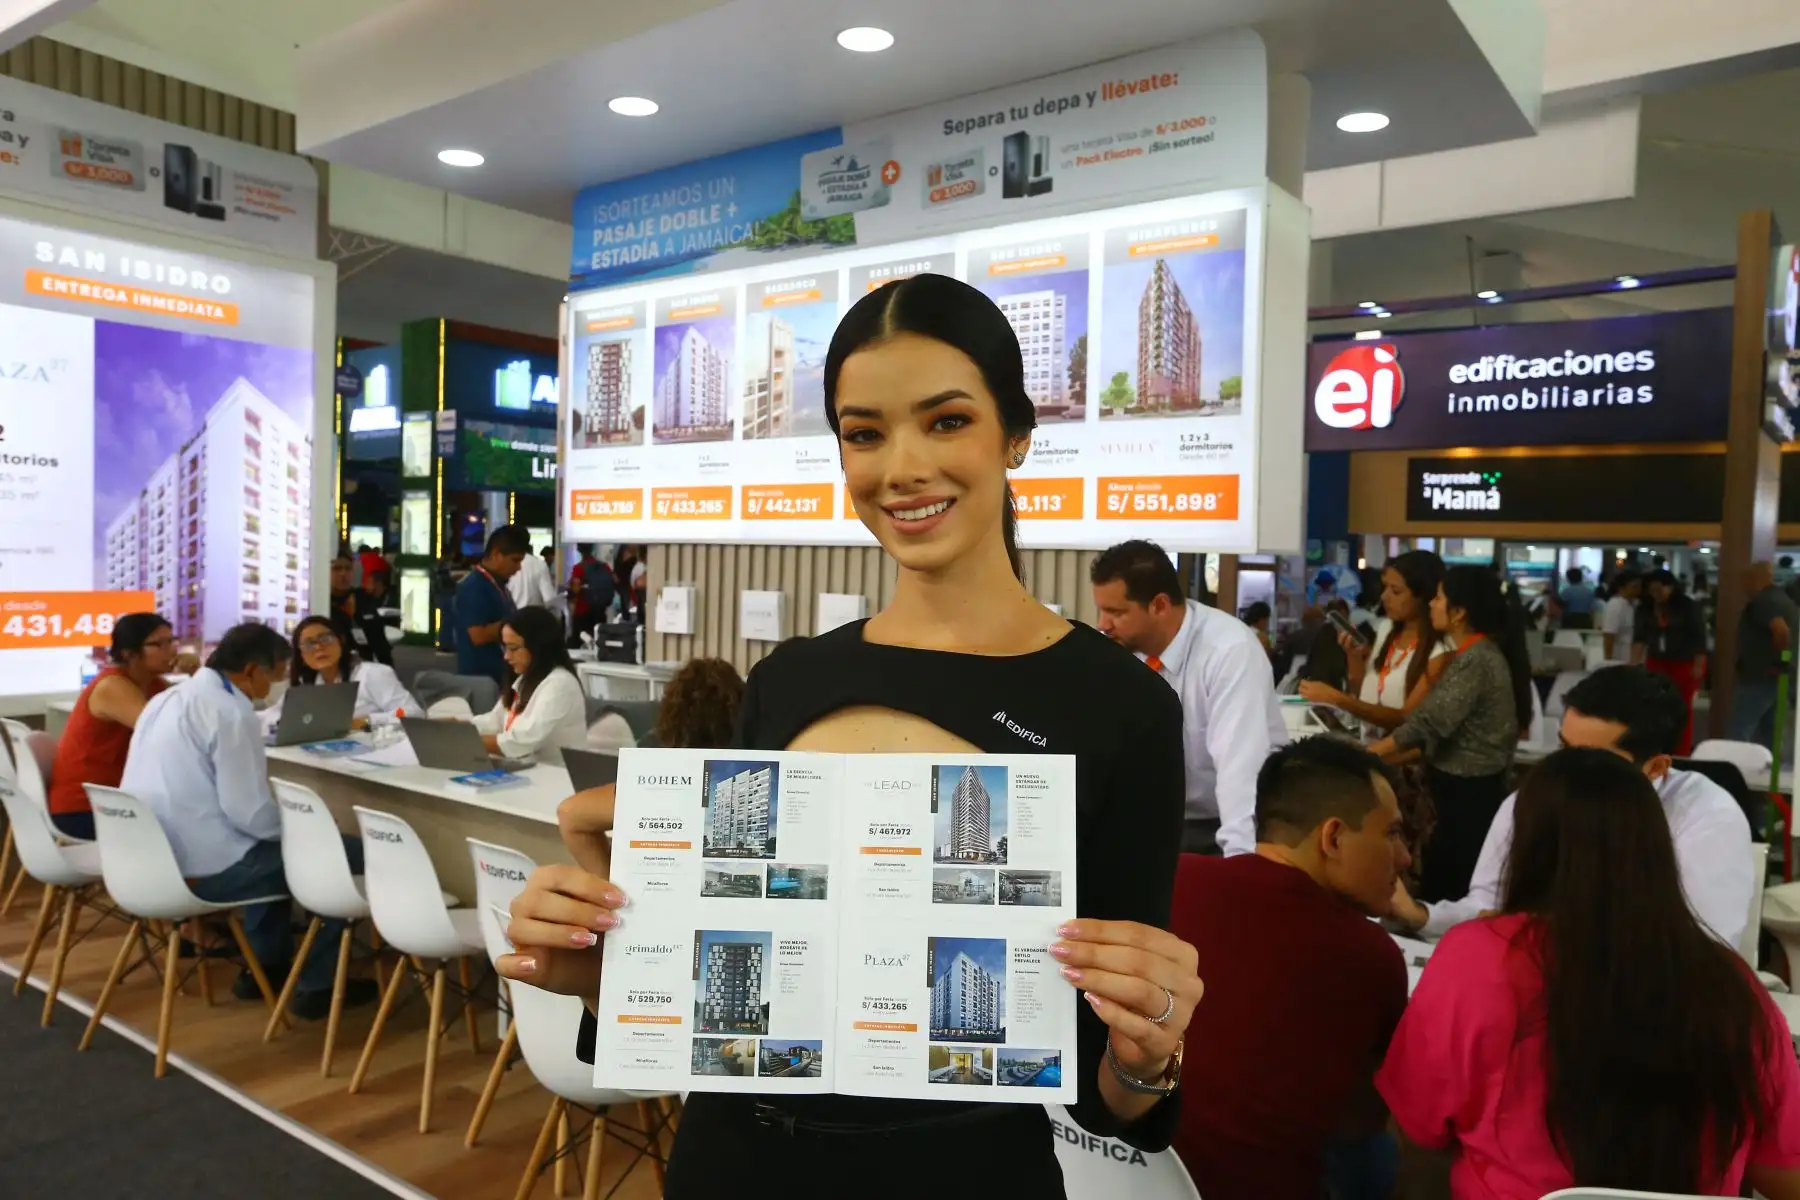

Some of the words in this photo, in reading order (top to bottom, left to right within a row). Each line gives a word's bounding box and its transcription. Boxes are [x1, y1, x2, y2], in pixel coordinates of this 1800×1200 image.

[943, 111, 1006, 137] Separa
[1009, 105, 1029, 122] tu
[1033, 95, 1082, 116] depa
[1086, 90, 1097, 108] y
[1101, 72, 1180, 101] llévate:
[0, 109, 15, 122] a
[0, 130, 14, 143] a
[18, 134, 30, 149] y
[1173, 131, 1216, 149] sorteo!
[988, 165, 999, 177] o
[708, 175, 736, 199] UN
[593, 216, 656, 247] PASAJE
[660, 203, 722, 234] DOBLE
[591, 237, 659, 270] ESTADÍA
[663, 236, 675, 257] A
[679, 220, 760, 256] JAMAICA!
[35, 240, 106, 273] SAN
[119, 256, 232, 295] ISIDRO
[41, 276, 129, 304] ENTREGA
[132, 292, 226, 319] INMEDIATA
[1448, 349, 1656, 384] edificaciones
[1448, 382, 1654, 414] inmobiliarias
[1179, 442, 1233, 452] dormitorios
[1108, 482, 1134, 491] Ahora
[1422, 471, 1482, 487] Sorprende
[747, 498, 762, 515] S/
[764, 498, 817, 514] 442,131
[1107, 493, 1129, 514] S/
[1133, 493, 1217, 512] 551,898
[1422, 486, 1432, 498] a
[1432, 485, 1501, 511] Mamá
[656, 500, 671, 516] S/
[3, 611, 122, 639] 431,48
[1006, 719, 1048, 748] EDIFICA
[637, 775, 692, 786] BOHEM
[873, 779, 912, 790] LEAD
[638, 821, 648, 830] S/
[648, 822, 684, 830] 564,502
[868, 827, 878, 836] S/
[879, 828, 911, 836] 467,972
[487, 863, 528, 883] EDIFICA
[627, 995, 637, 1004] S/
[638, 995, 673, 1004] 529,750
[862, 1002, 871, 1010] S/
[872, 1002, 908, 1011] 433,265
[1050, 1118, 1148, 1167] EDIFICA
